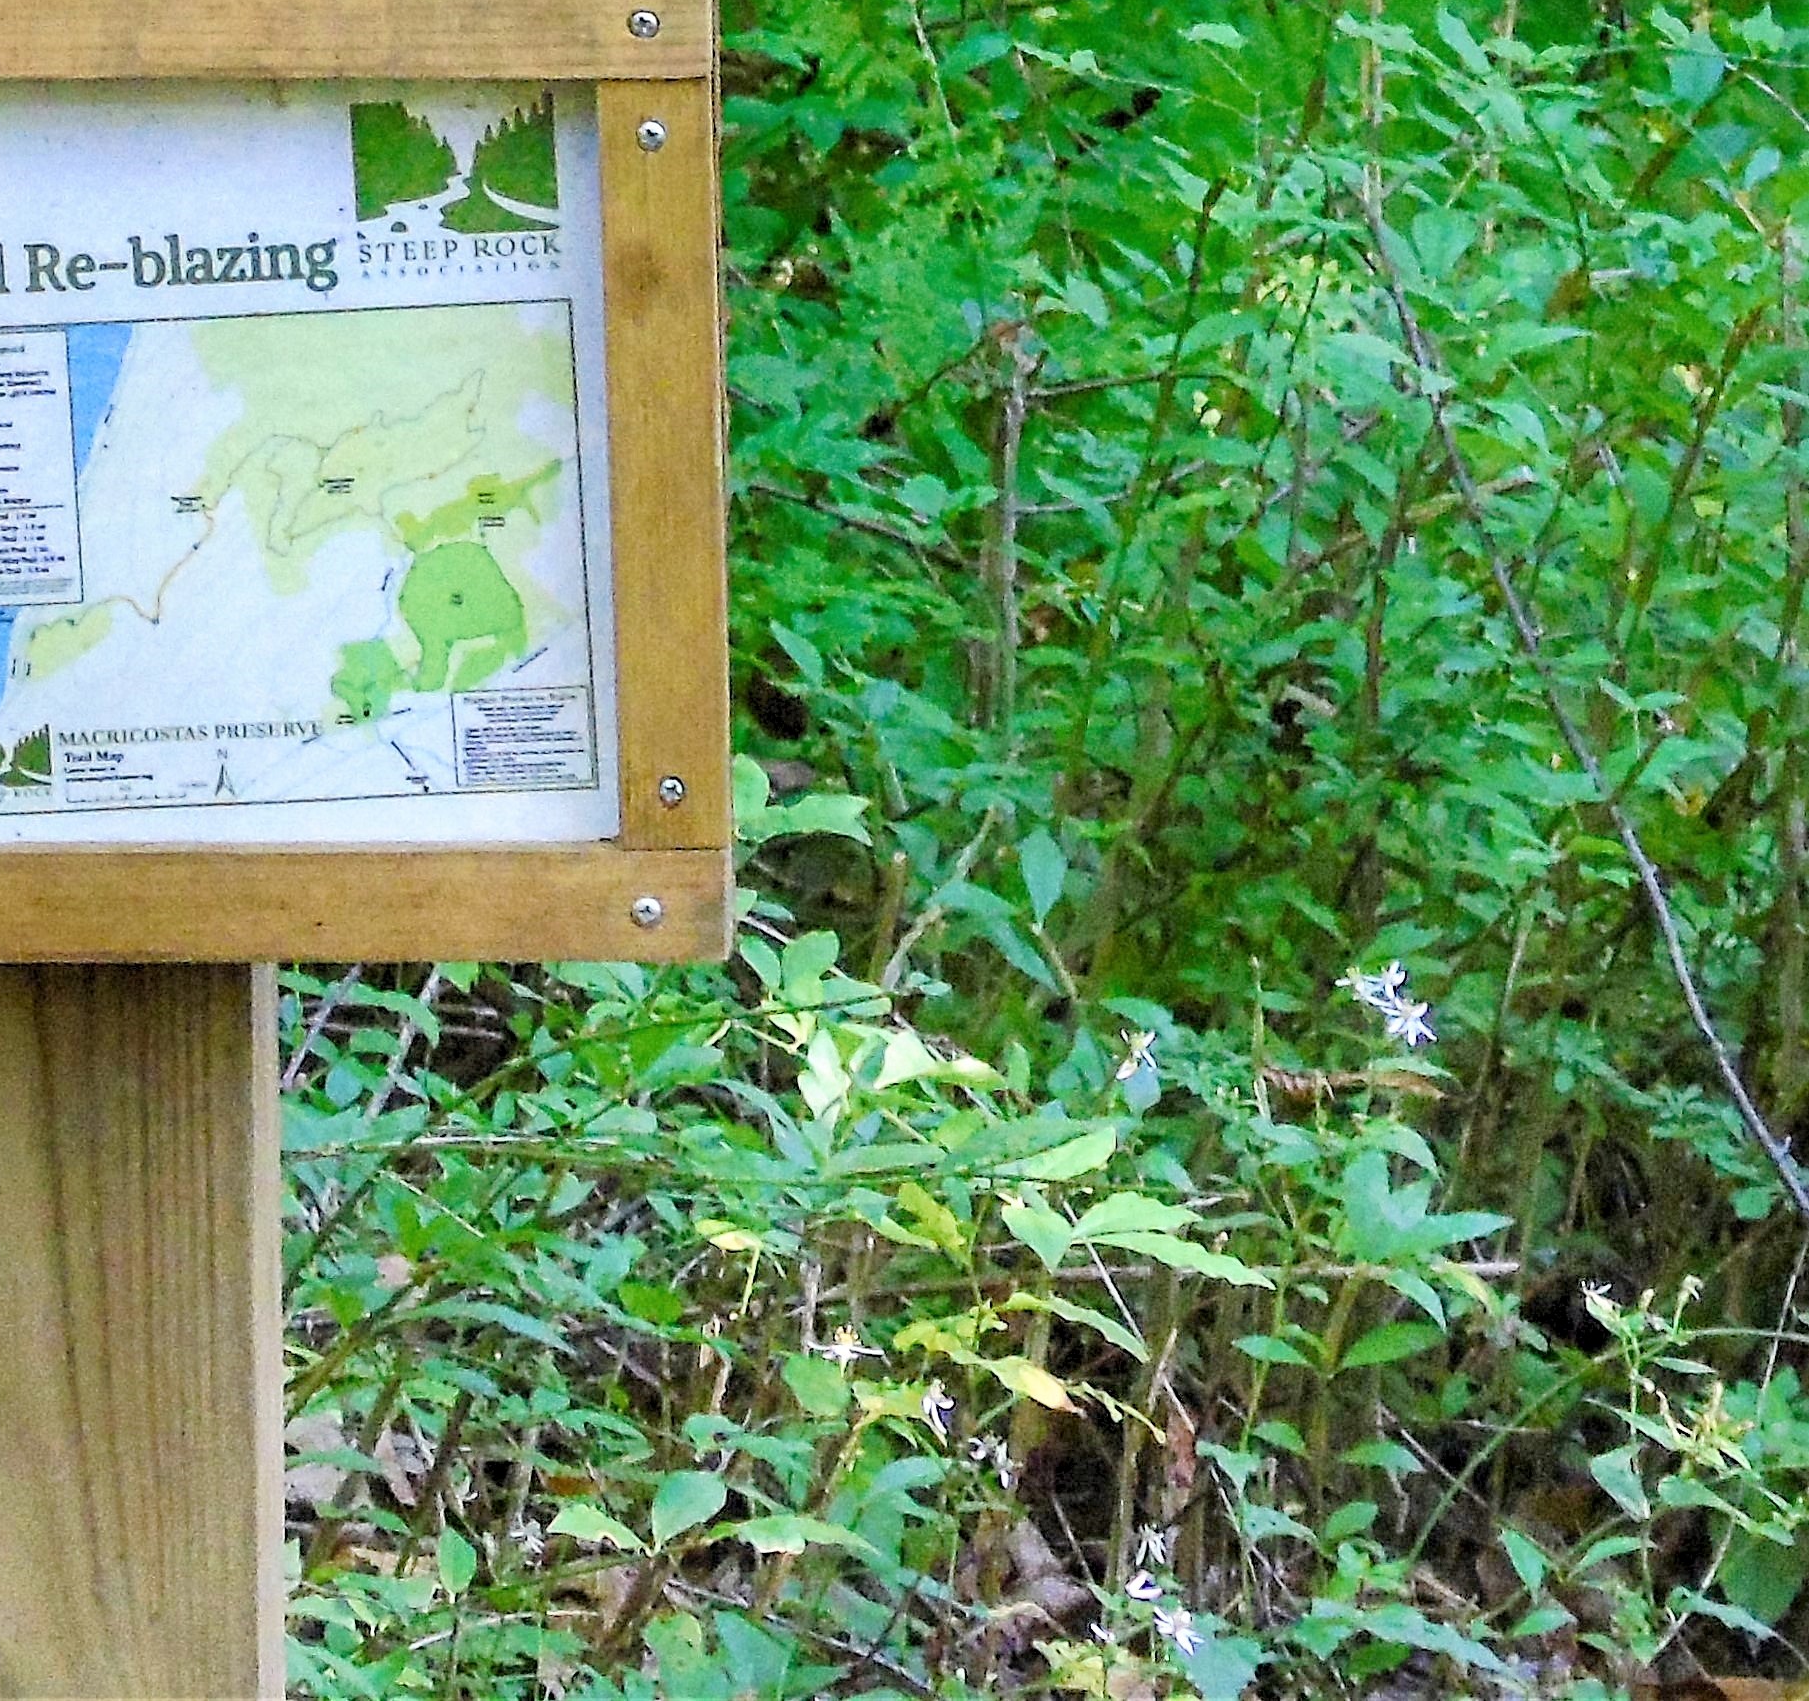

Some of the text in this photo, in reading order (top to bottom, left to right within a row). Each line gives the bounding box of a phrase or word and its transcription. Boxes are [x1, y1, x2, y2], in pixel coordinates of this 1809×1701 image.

[23, 232, 338, 292] Re-blazing
[358, 234, 561, 263] STEEP ROCK
[58, 727, 209, 747] MACRICOSTAS
[214, 721, 323, 740] PRESERVE
[64, 750, 124, 765] Trail Map
